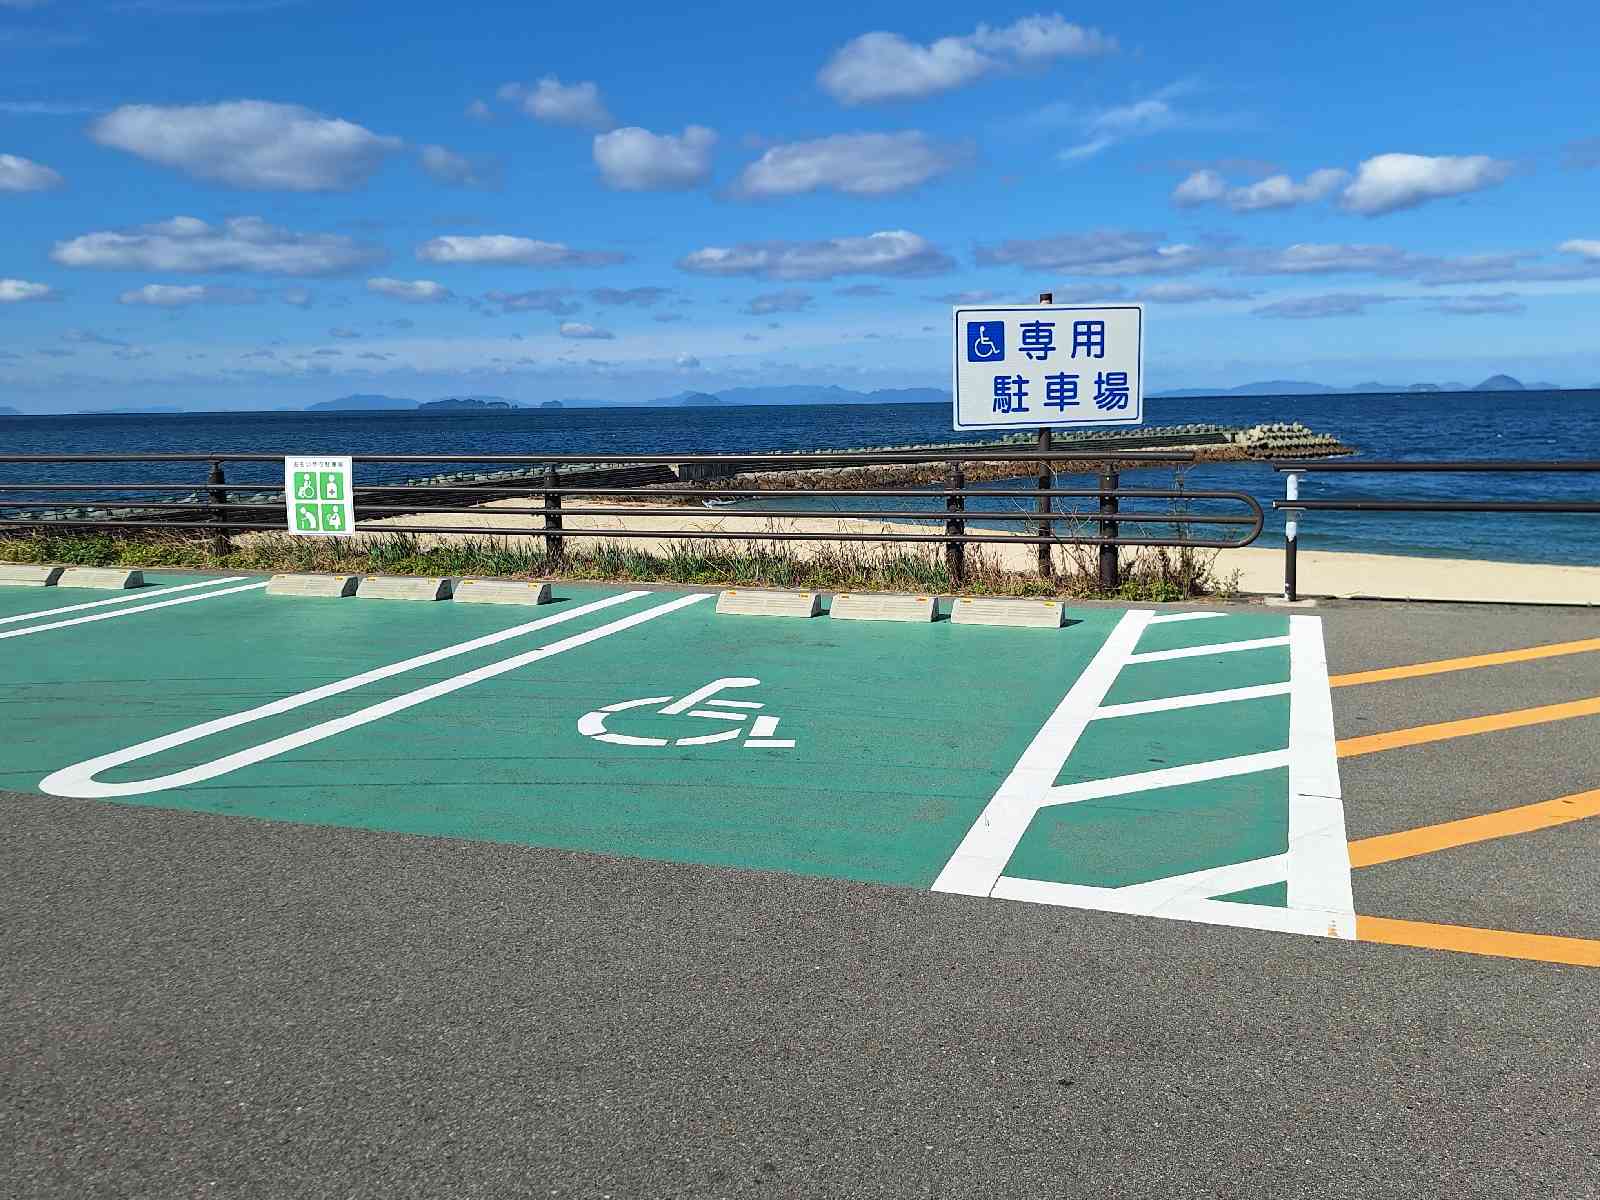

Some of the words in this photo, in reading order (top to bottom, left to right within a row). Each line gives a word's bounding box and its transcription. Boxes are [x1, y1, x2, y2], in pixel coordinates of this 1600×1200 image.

[1018, 319, 1106, 360] 専用
[992, 371, 1130, 414] 駐車場
